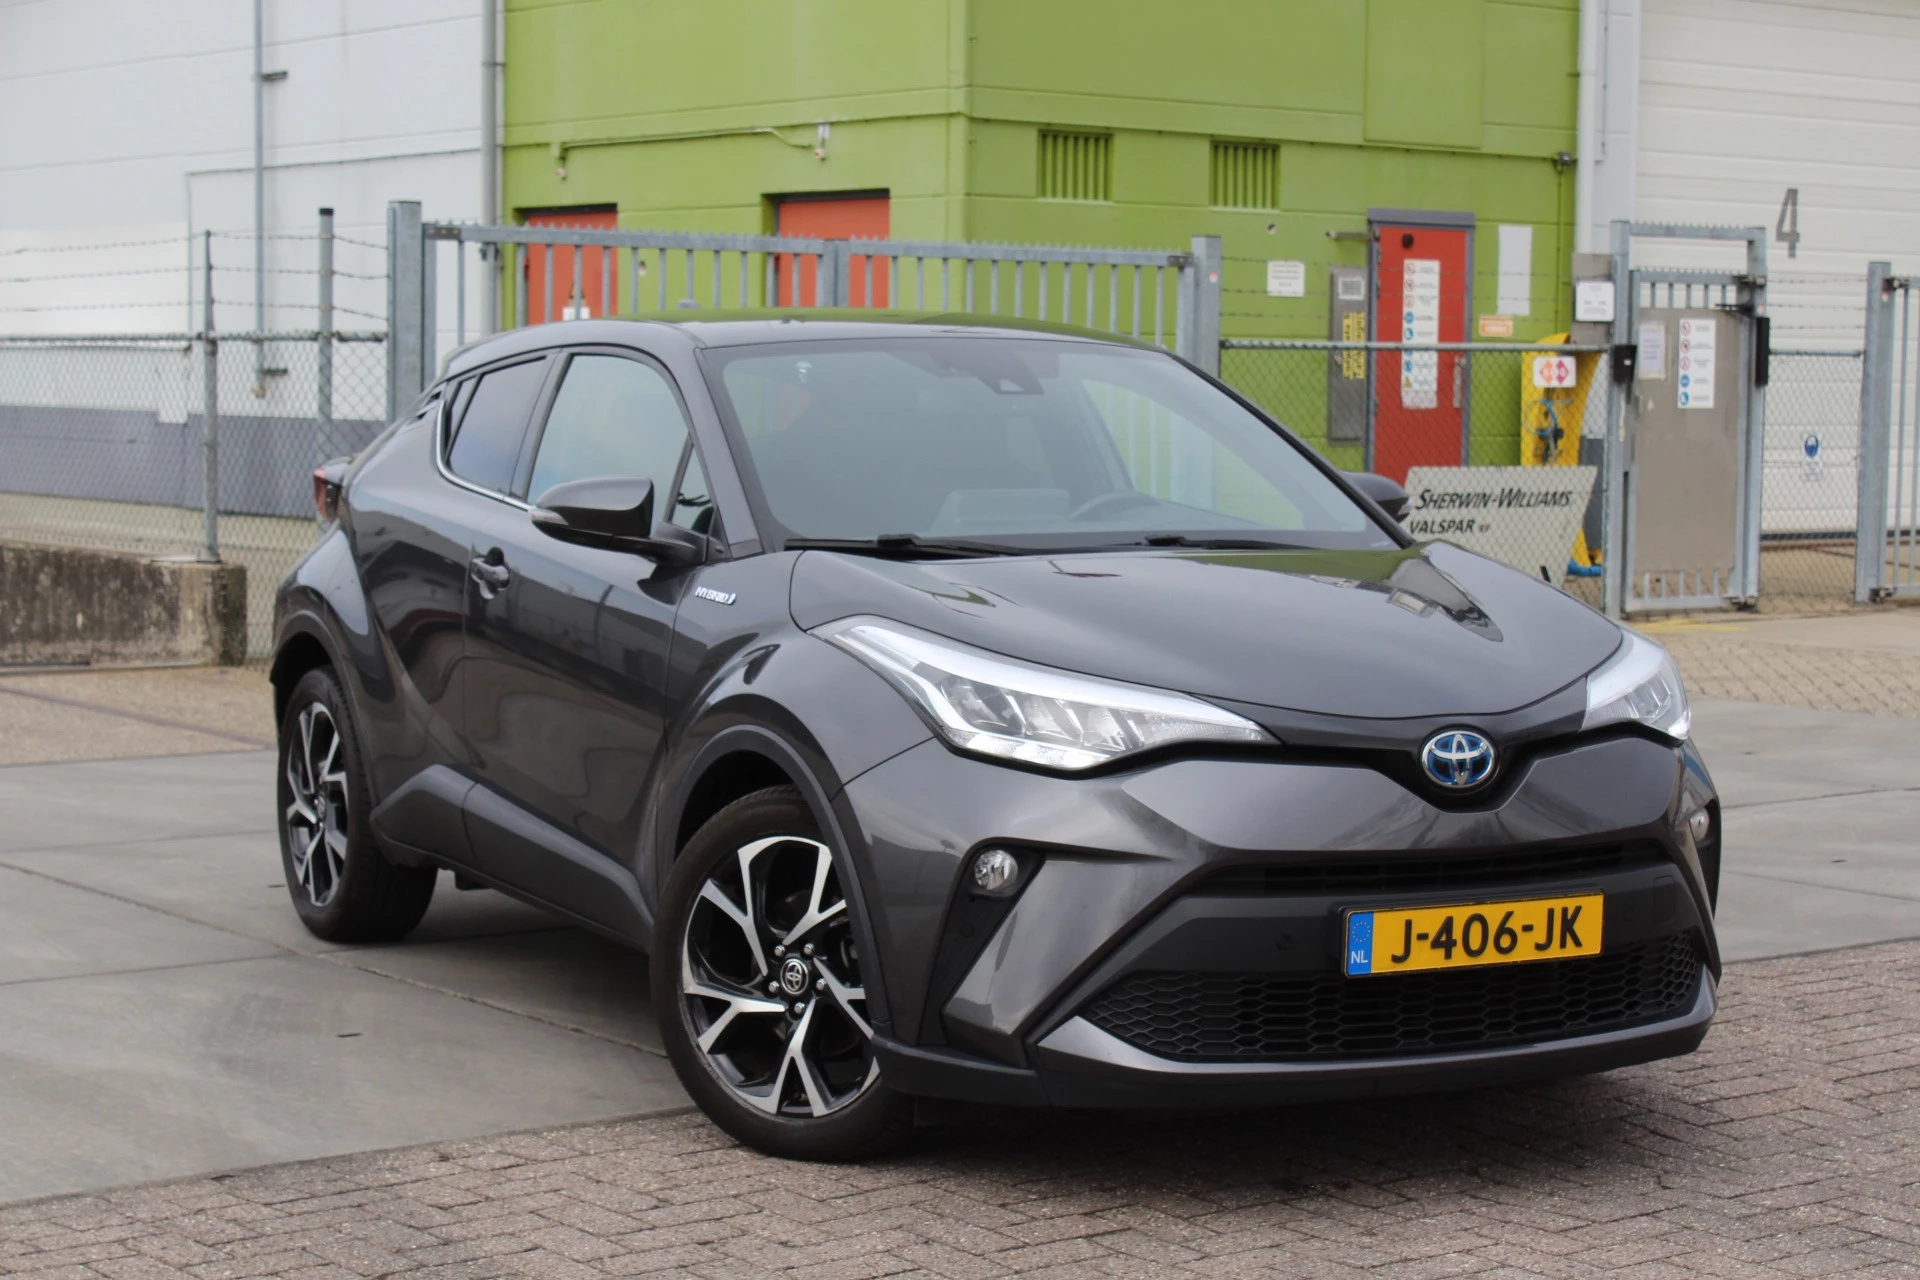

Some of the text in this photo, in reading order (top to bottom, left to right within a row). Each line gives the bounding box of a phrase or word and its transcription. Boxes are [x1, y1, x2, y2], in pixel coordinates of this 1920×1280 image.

[1775, 188, 1800, 259] 4
[1415, 488, 1573, 510] SHERWIN-WILLIAMS
[1410, 519, 1475, 534] VALSPAR
[1350, 905, 1583, 965] NL J-406-JK
